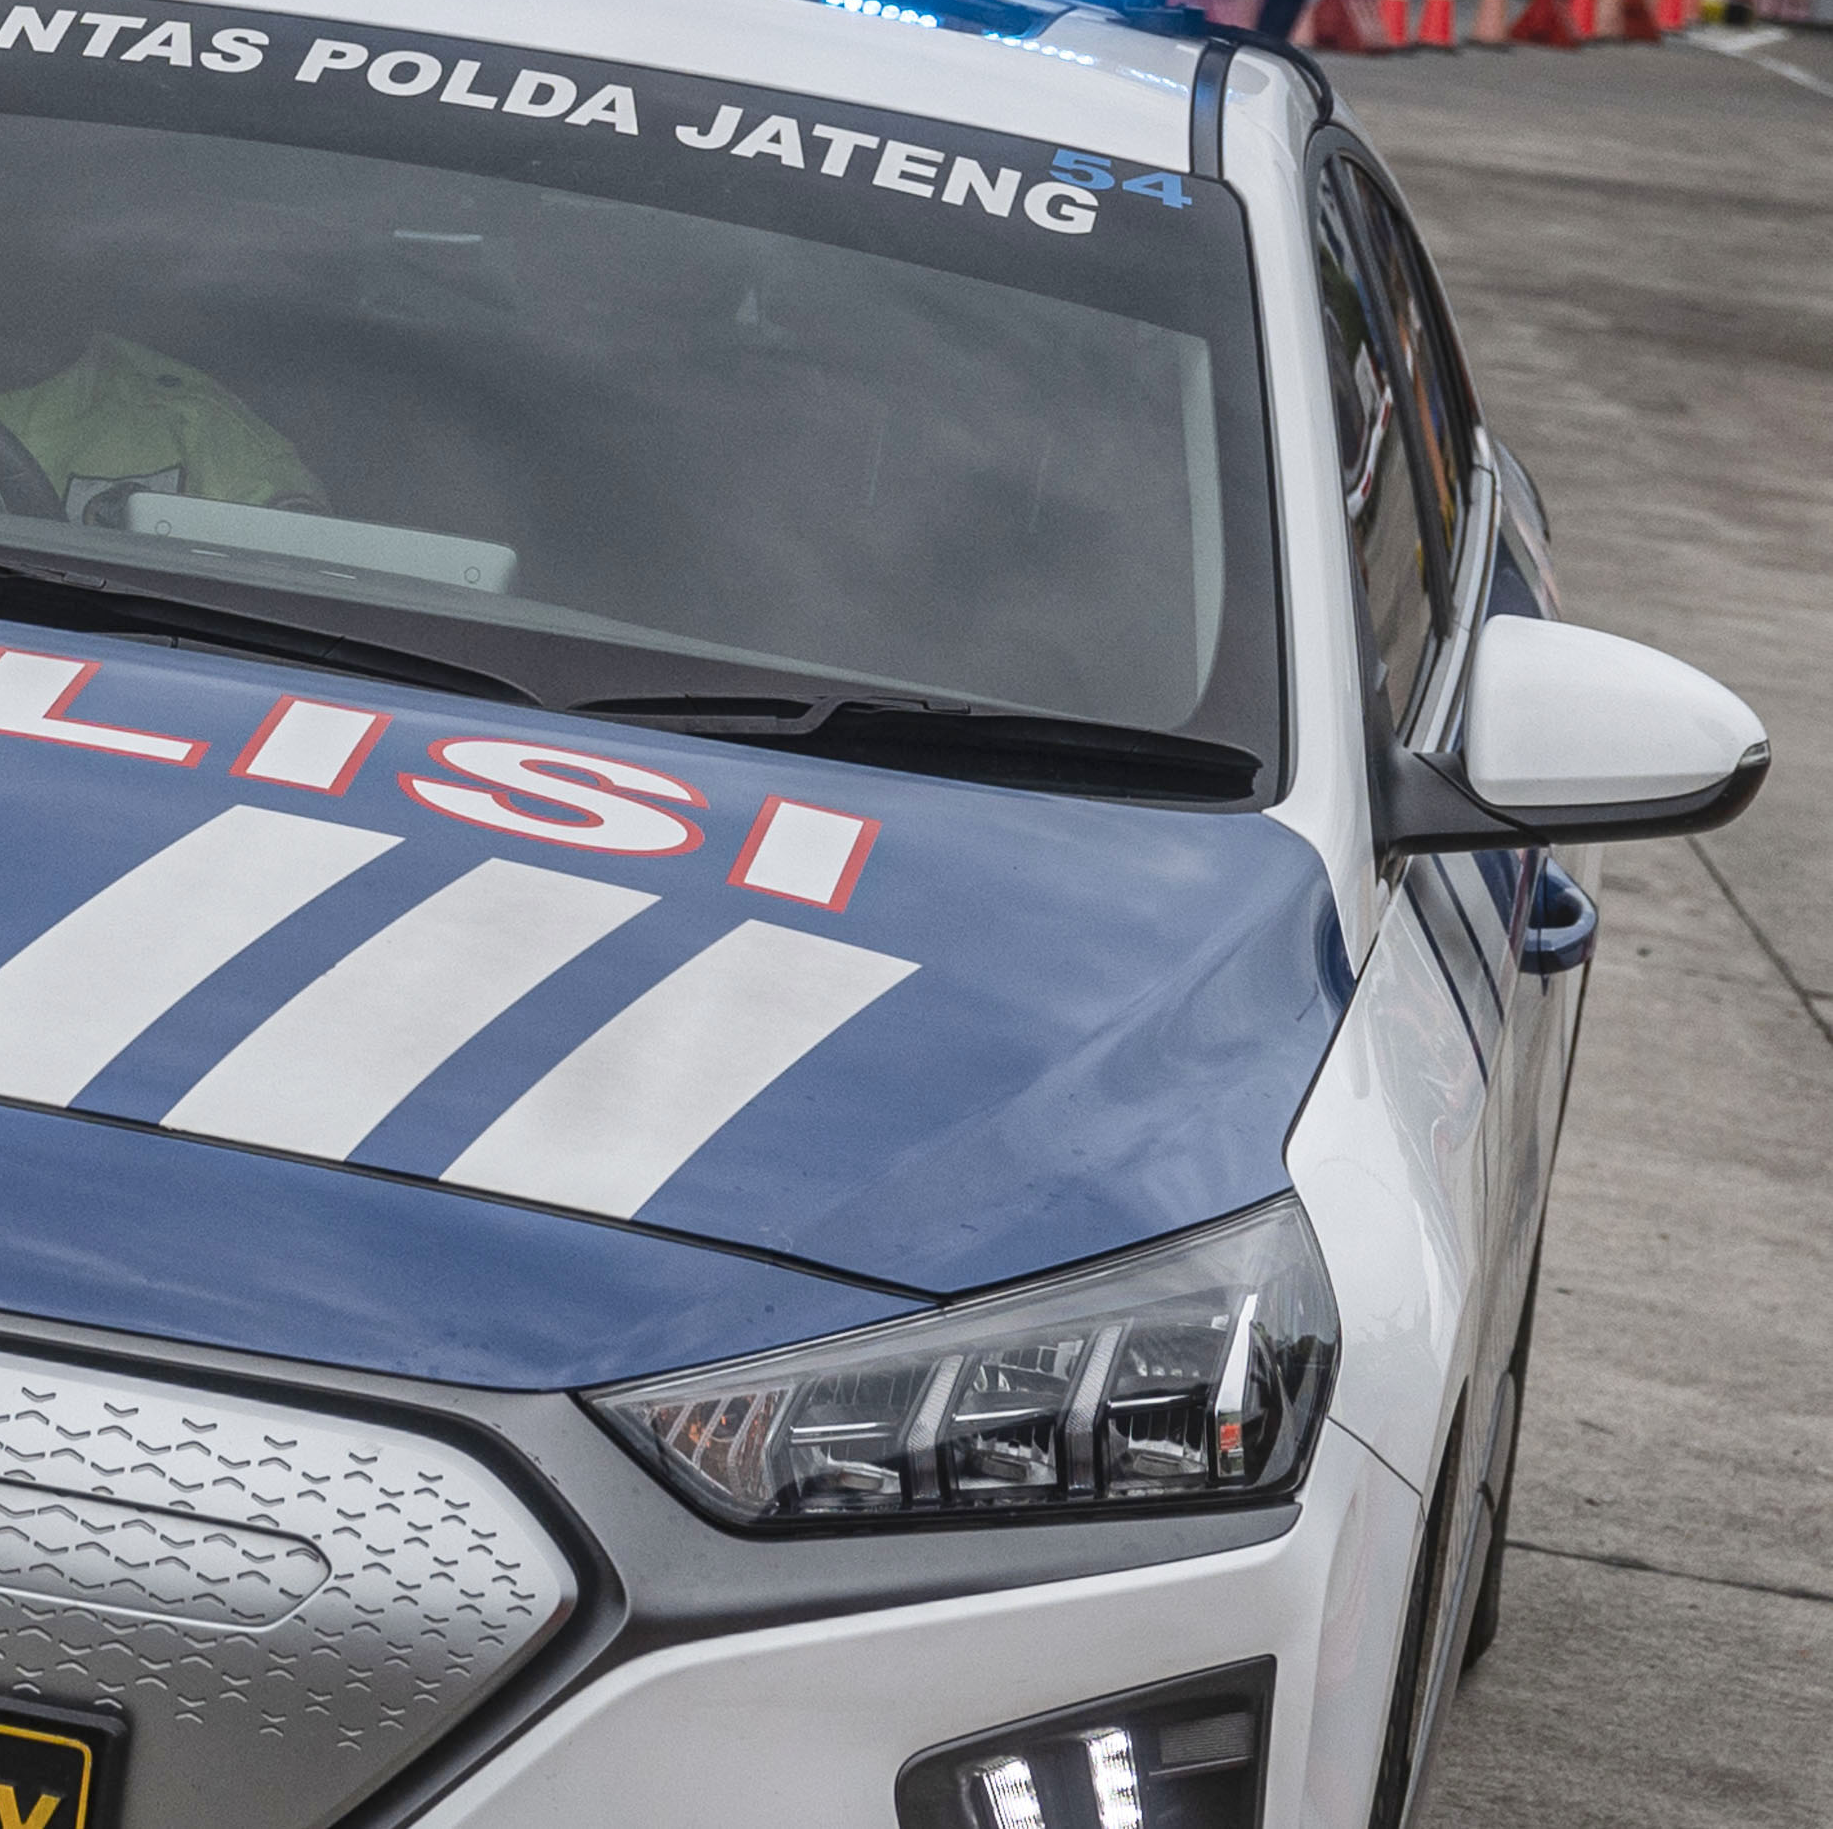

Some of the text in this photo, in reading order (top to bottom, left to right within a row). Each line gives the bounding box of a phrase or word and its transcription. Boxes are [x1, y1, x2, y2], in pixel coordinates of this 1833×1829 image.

[294, 38, 640, 137] POLDA
[675, 103, 1099, 235] JATENG
[1049, 147, 1192, 210] 54
